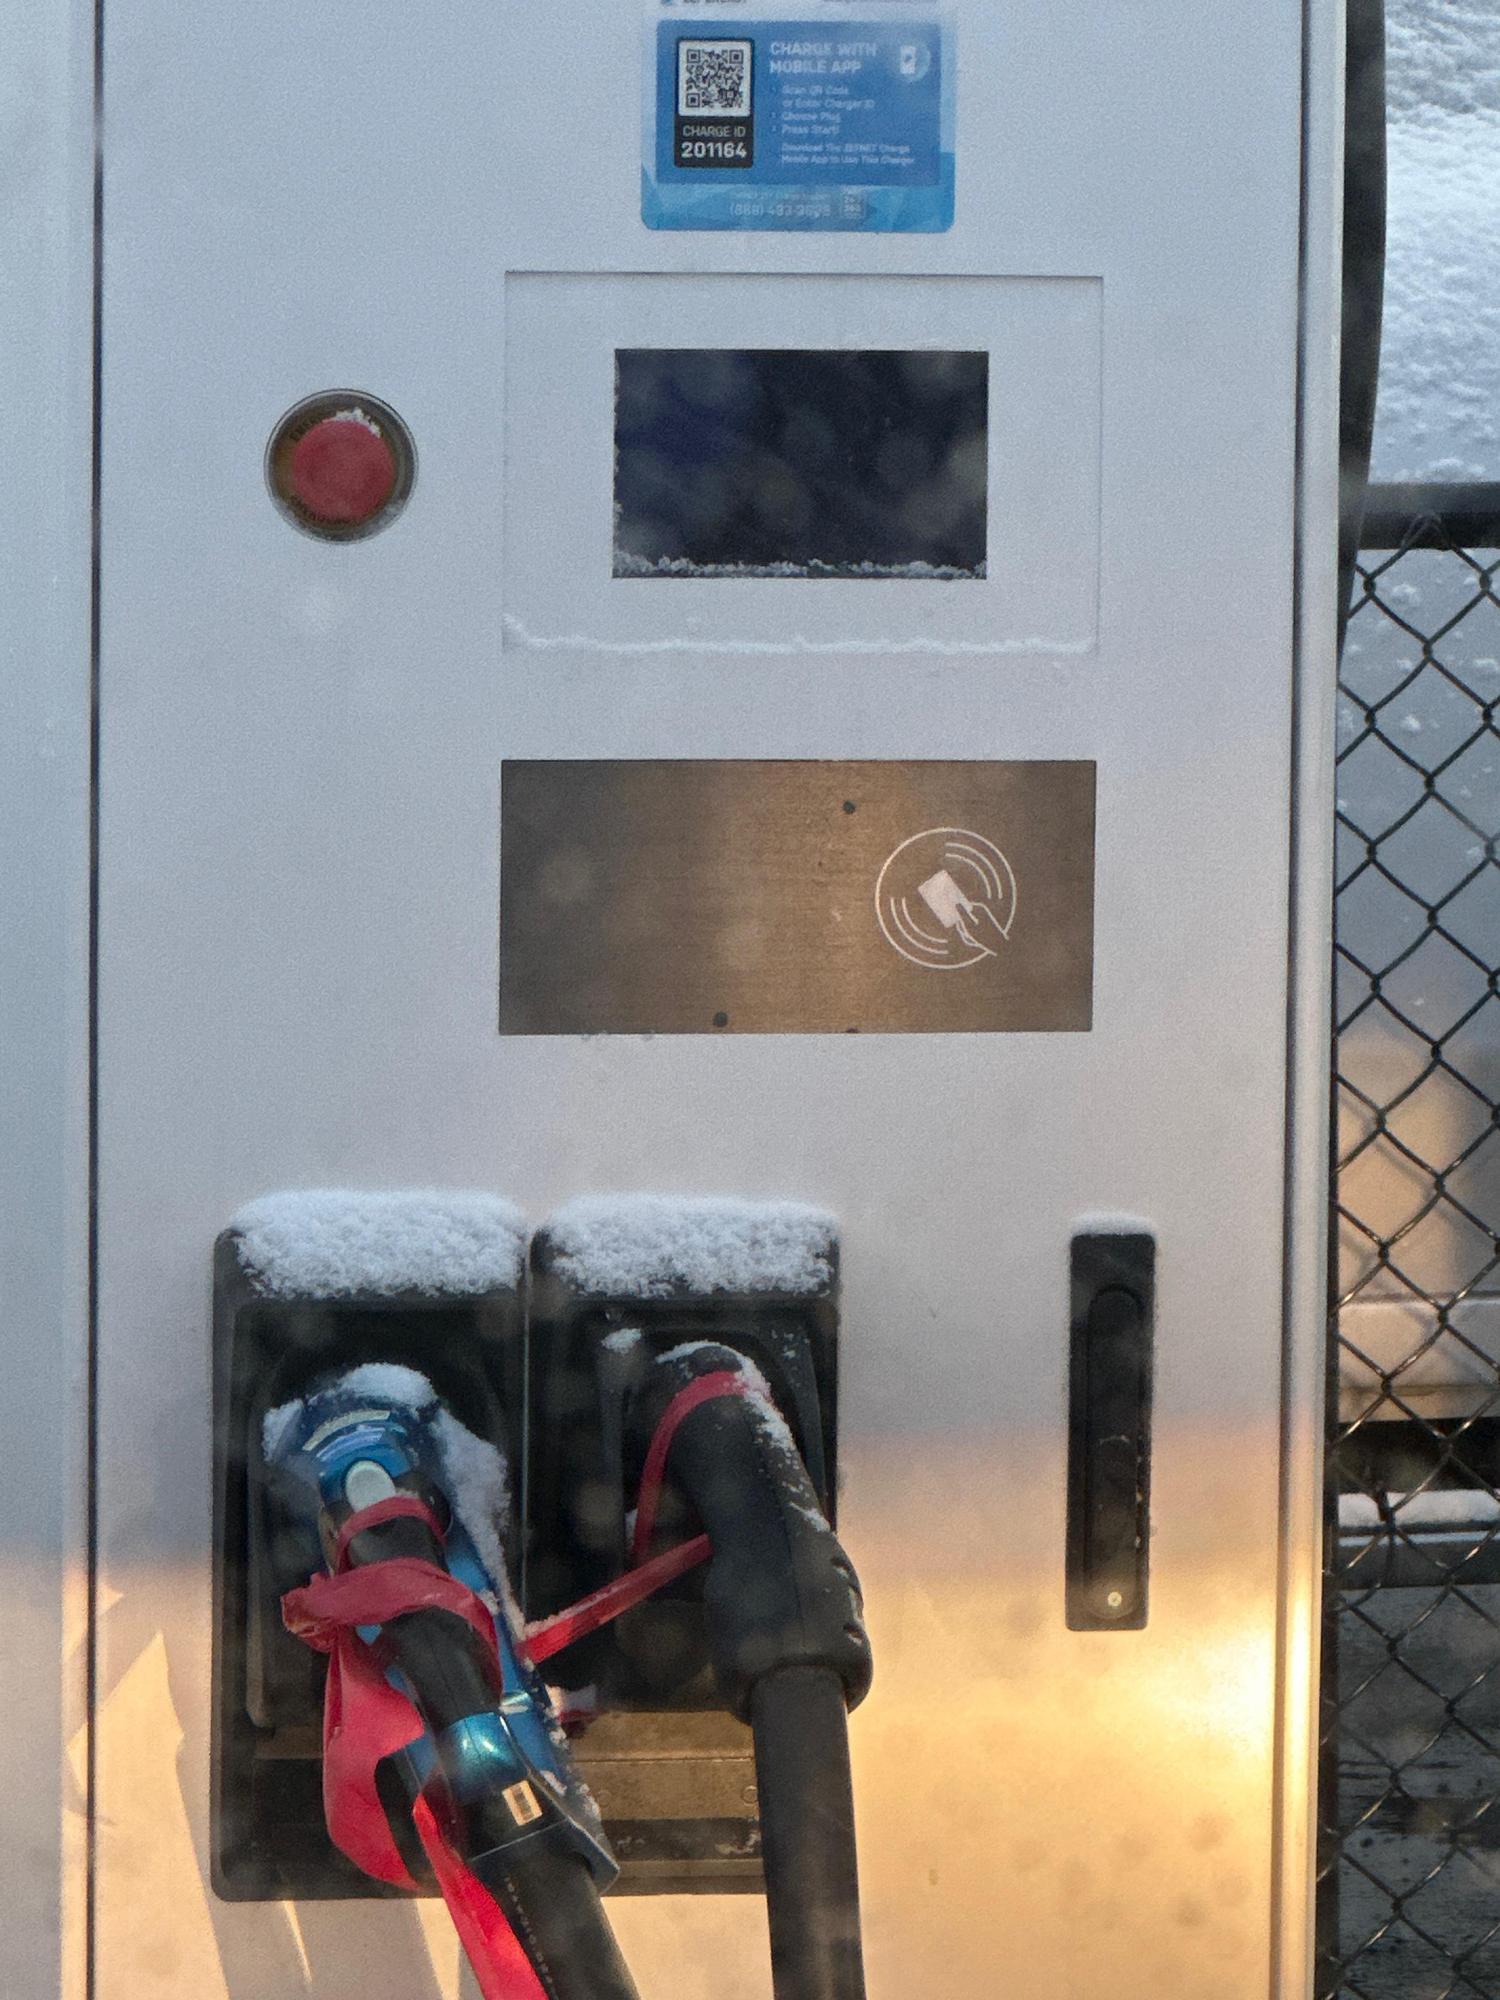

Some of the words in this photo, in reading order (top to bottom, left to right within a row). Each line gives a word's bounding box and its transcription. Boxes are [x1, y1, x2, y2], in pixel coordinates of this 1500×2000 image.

[769, 42, 833, 56] CHARGE
[769, 60, 827, 74] MOBILE
[830, 60, 862, 74] APP
[682, 125, 732, 137] CHARGE
[734, 125, 746, 138] ID
[681, 141, 747, 158] 201164
